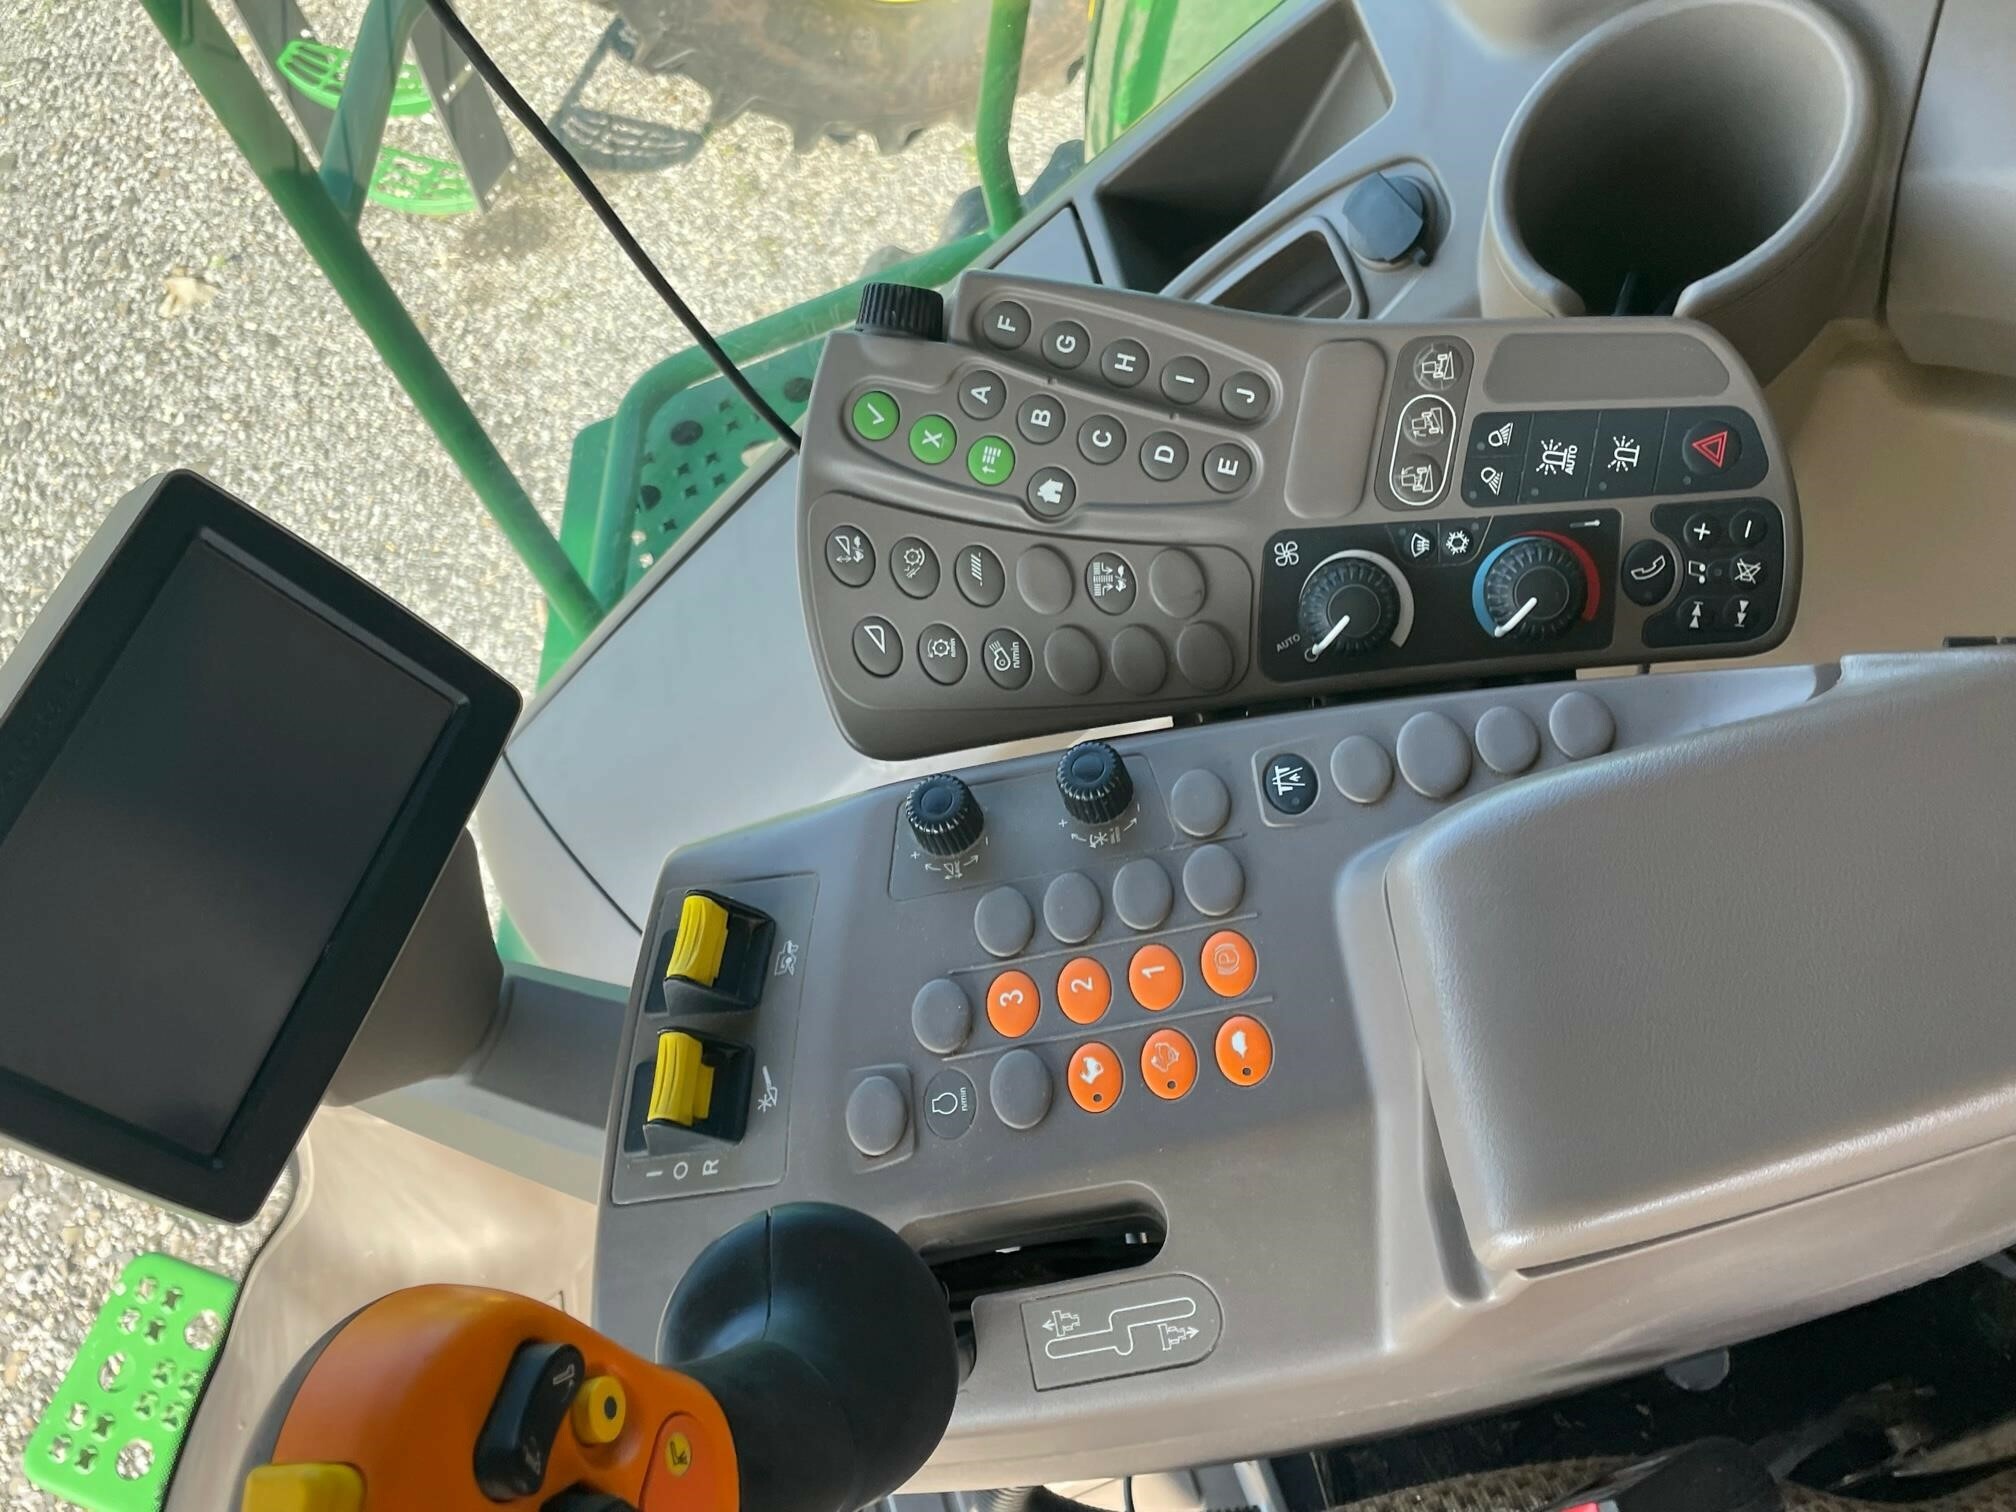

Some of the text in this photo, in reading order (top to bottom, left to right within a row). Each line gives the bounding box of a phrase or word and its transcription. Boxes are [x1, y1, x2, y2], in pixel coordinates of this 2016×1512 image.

[998, 316, 1015, 331] F
[1057, 334, 1076, 353] G
[1115, 353, 1135, 371] H
[971, 387, 991, 404] A
[1237, 389, 1255, 403] J
[1031, 409, 1050, 426] B
[922, 430, 942, 448] X
[1092, 430, 1111, 447] C
[1154, 446, 1174, 463] D
[1566, 445, 1577, 475] AUTO
[1218, 458, 1238, 475] E
[1277, 634, 1301, 652] AUTO
[1142, 966, 1164, 978] 1
[1071, 978, 1092, 993] 2
[999, 990, 1023, 1006] 3
[703, 1160, 719, 1175] R
